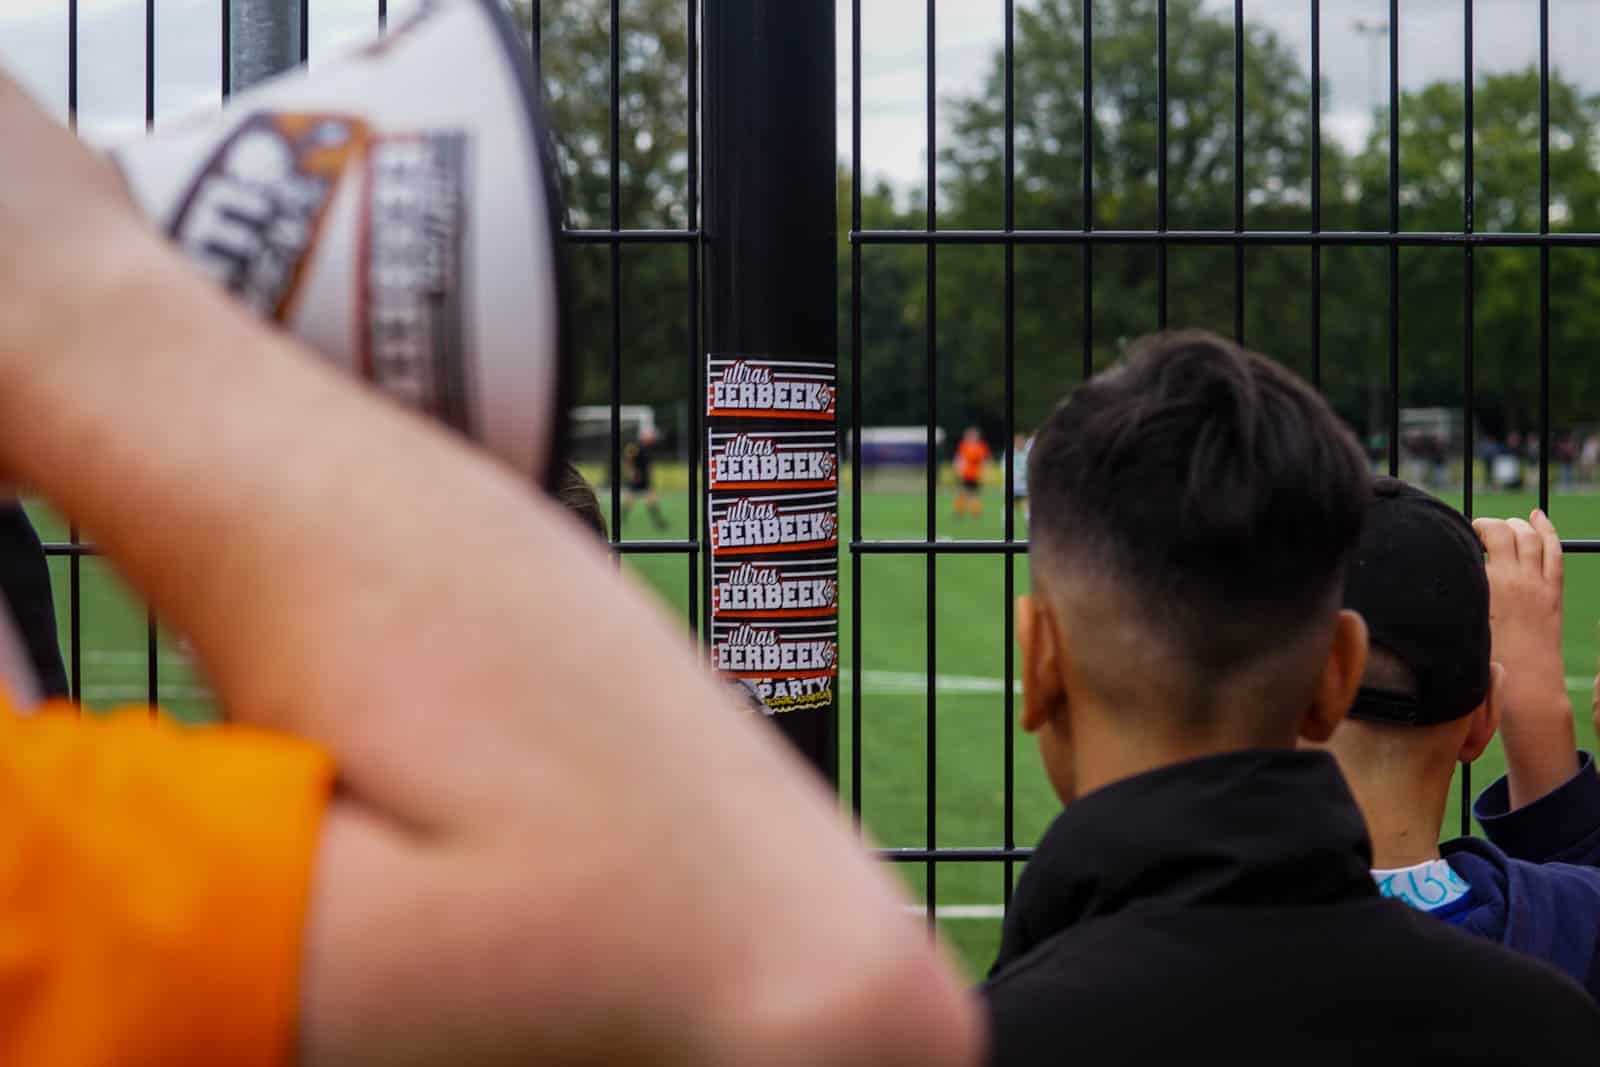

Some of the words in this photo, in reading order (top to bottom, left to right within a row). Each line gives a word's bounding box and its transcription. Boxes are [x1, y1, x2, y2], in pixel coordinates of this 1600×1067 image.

[724, 361, 774, 384] ultras
[713, 381, 821, 410] EERBEEK
[726, 434, 776, 456] ultras
[715, 452, 825, 481] EERBEEK
[727, 499, 776, 521] ultras
[717, 512, 826, 547] EERBEEK
[729, 563, 779, 585] ultras
[719, 580, 827, 609] EERBEEK
[728, 624, 779, 647] ultras
[718, 641, 826, 670] EERBEEK
[758, 676, 828, 700] PARTY
